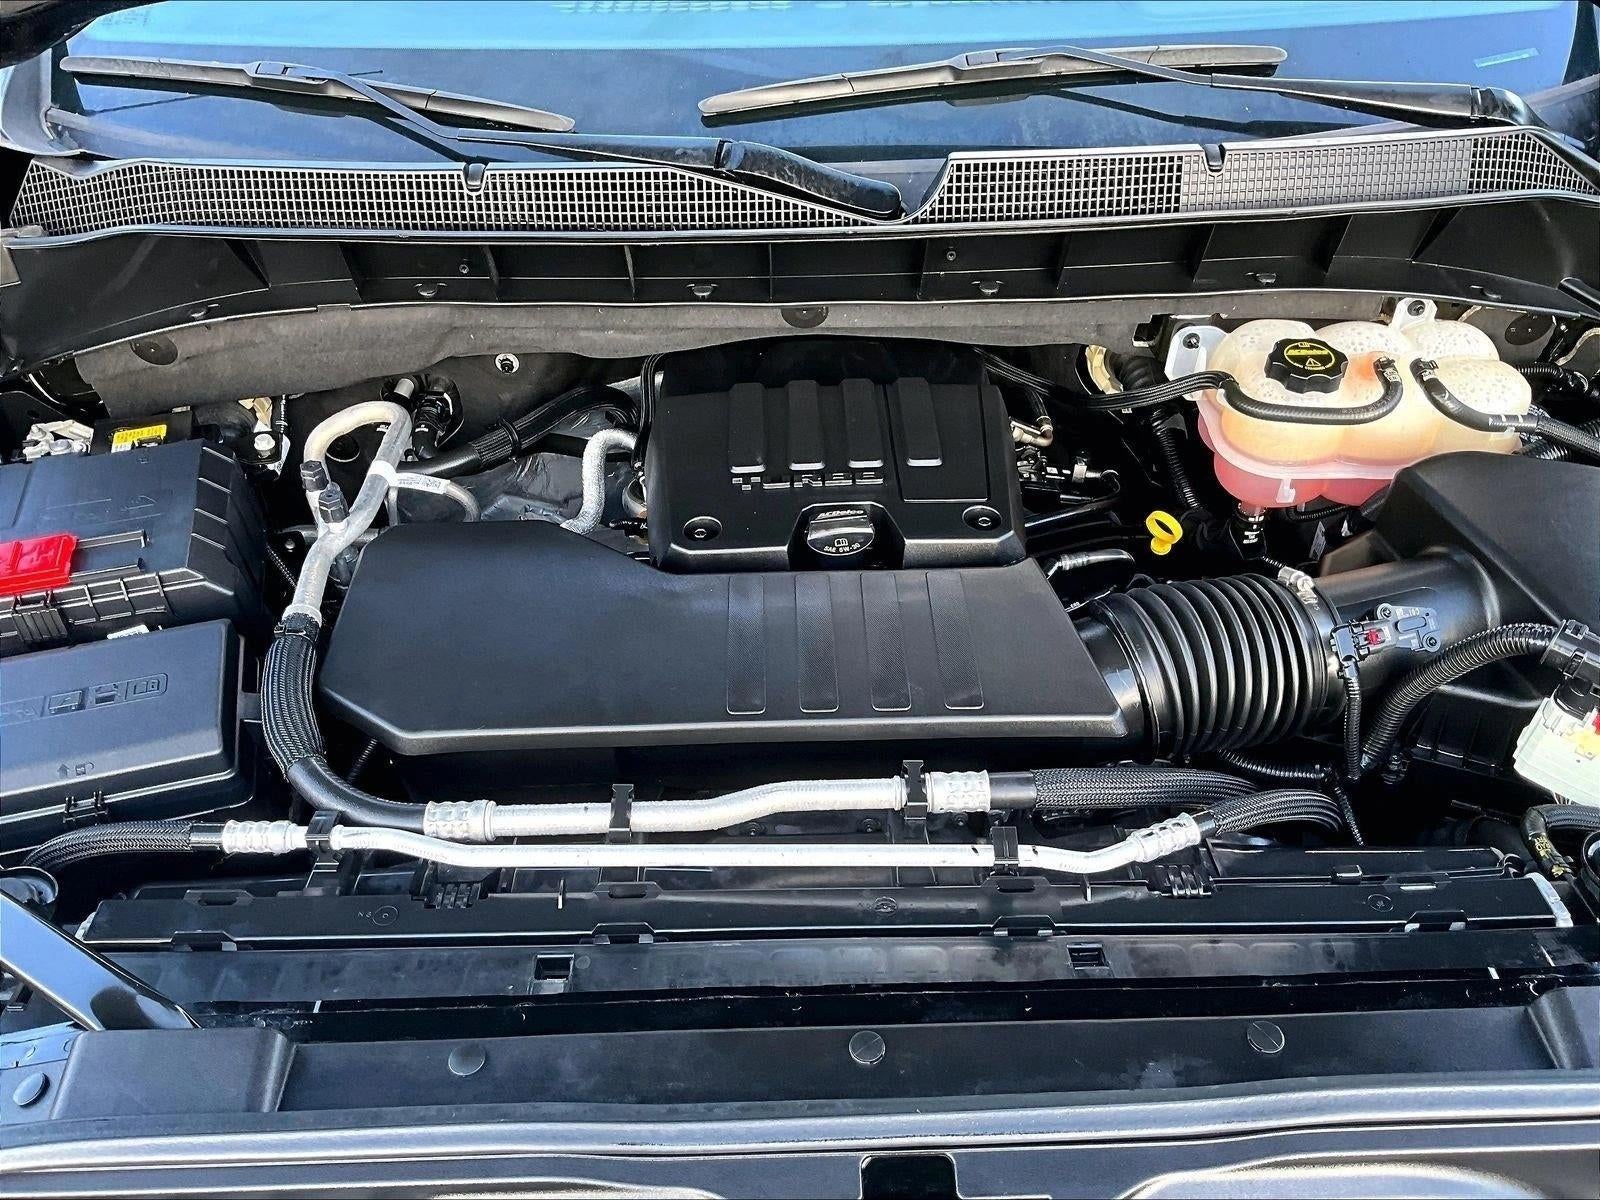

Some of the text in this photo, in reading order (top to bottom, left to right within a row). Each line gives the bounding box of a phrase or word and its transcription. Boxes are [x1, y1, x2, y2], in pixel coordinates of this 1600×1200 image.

[732, 471, 884, 490] TURBO
[815, 509, 864, 520] ACDelco
[823, 545, 836, 553] SAE
